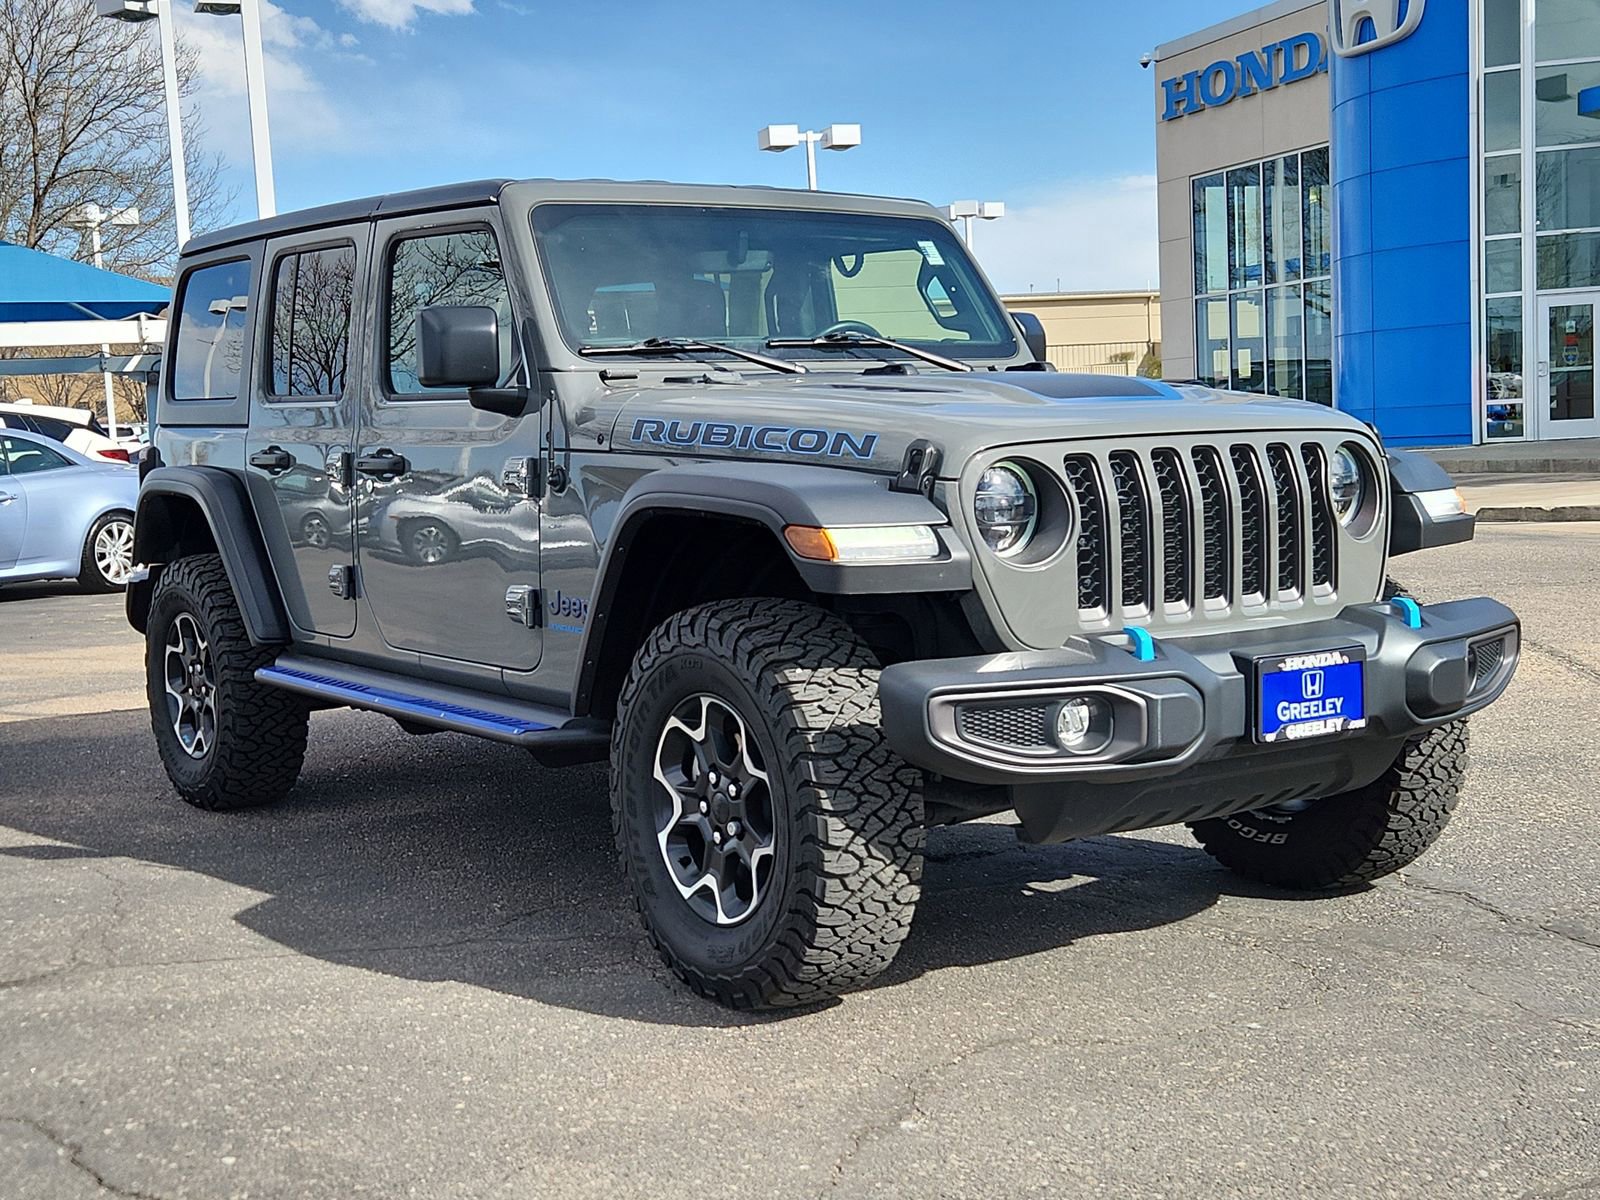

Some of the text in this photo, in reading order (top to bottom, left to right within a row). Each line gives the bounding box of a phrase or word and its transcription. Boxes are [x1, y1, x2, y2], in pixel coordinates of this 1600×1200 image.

[1161, 31, 1329, 121] HOND
[630, 418, 879, 459] RUBICON
[1283, 652, 1343, 671] HONDA
[1276, 697, 1344, 722] GREELEY
[1285, 718, 1344, 740] GREELEY
